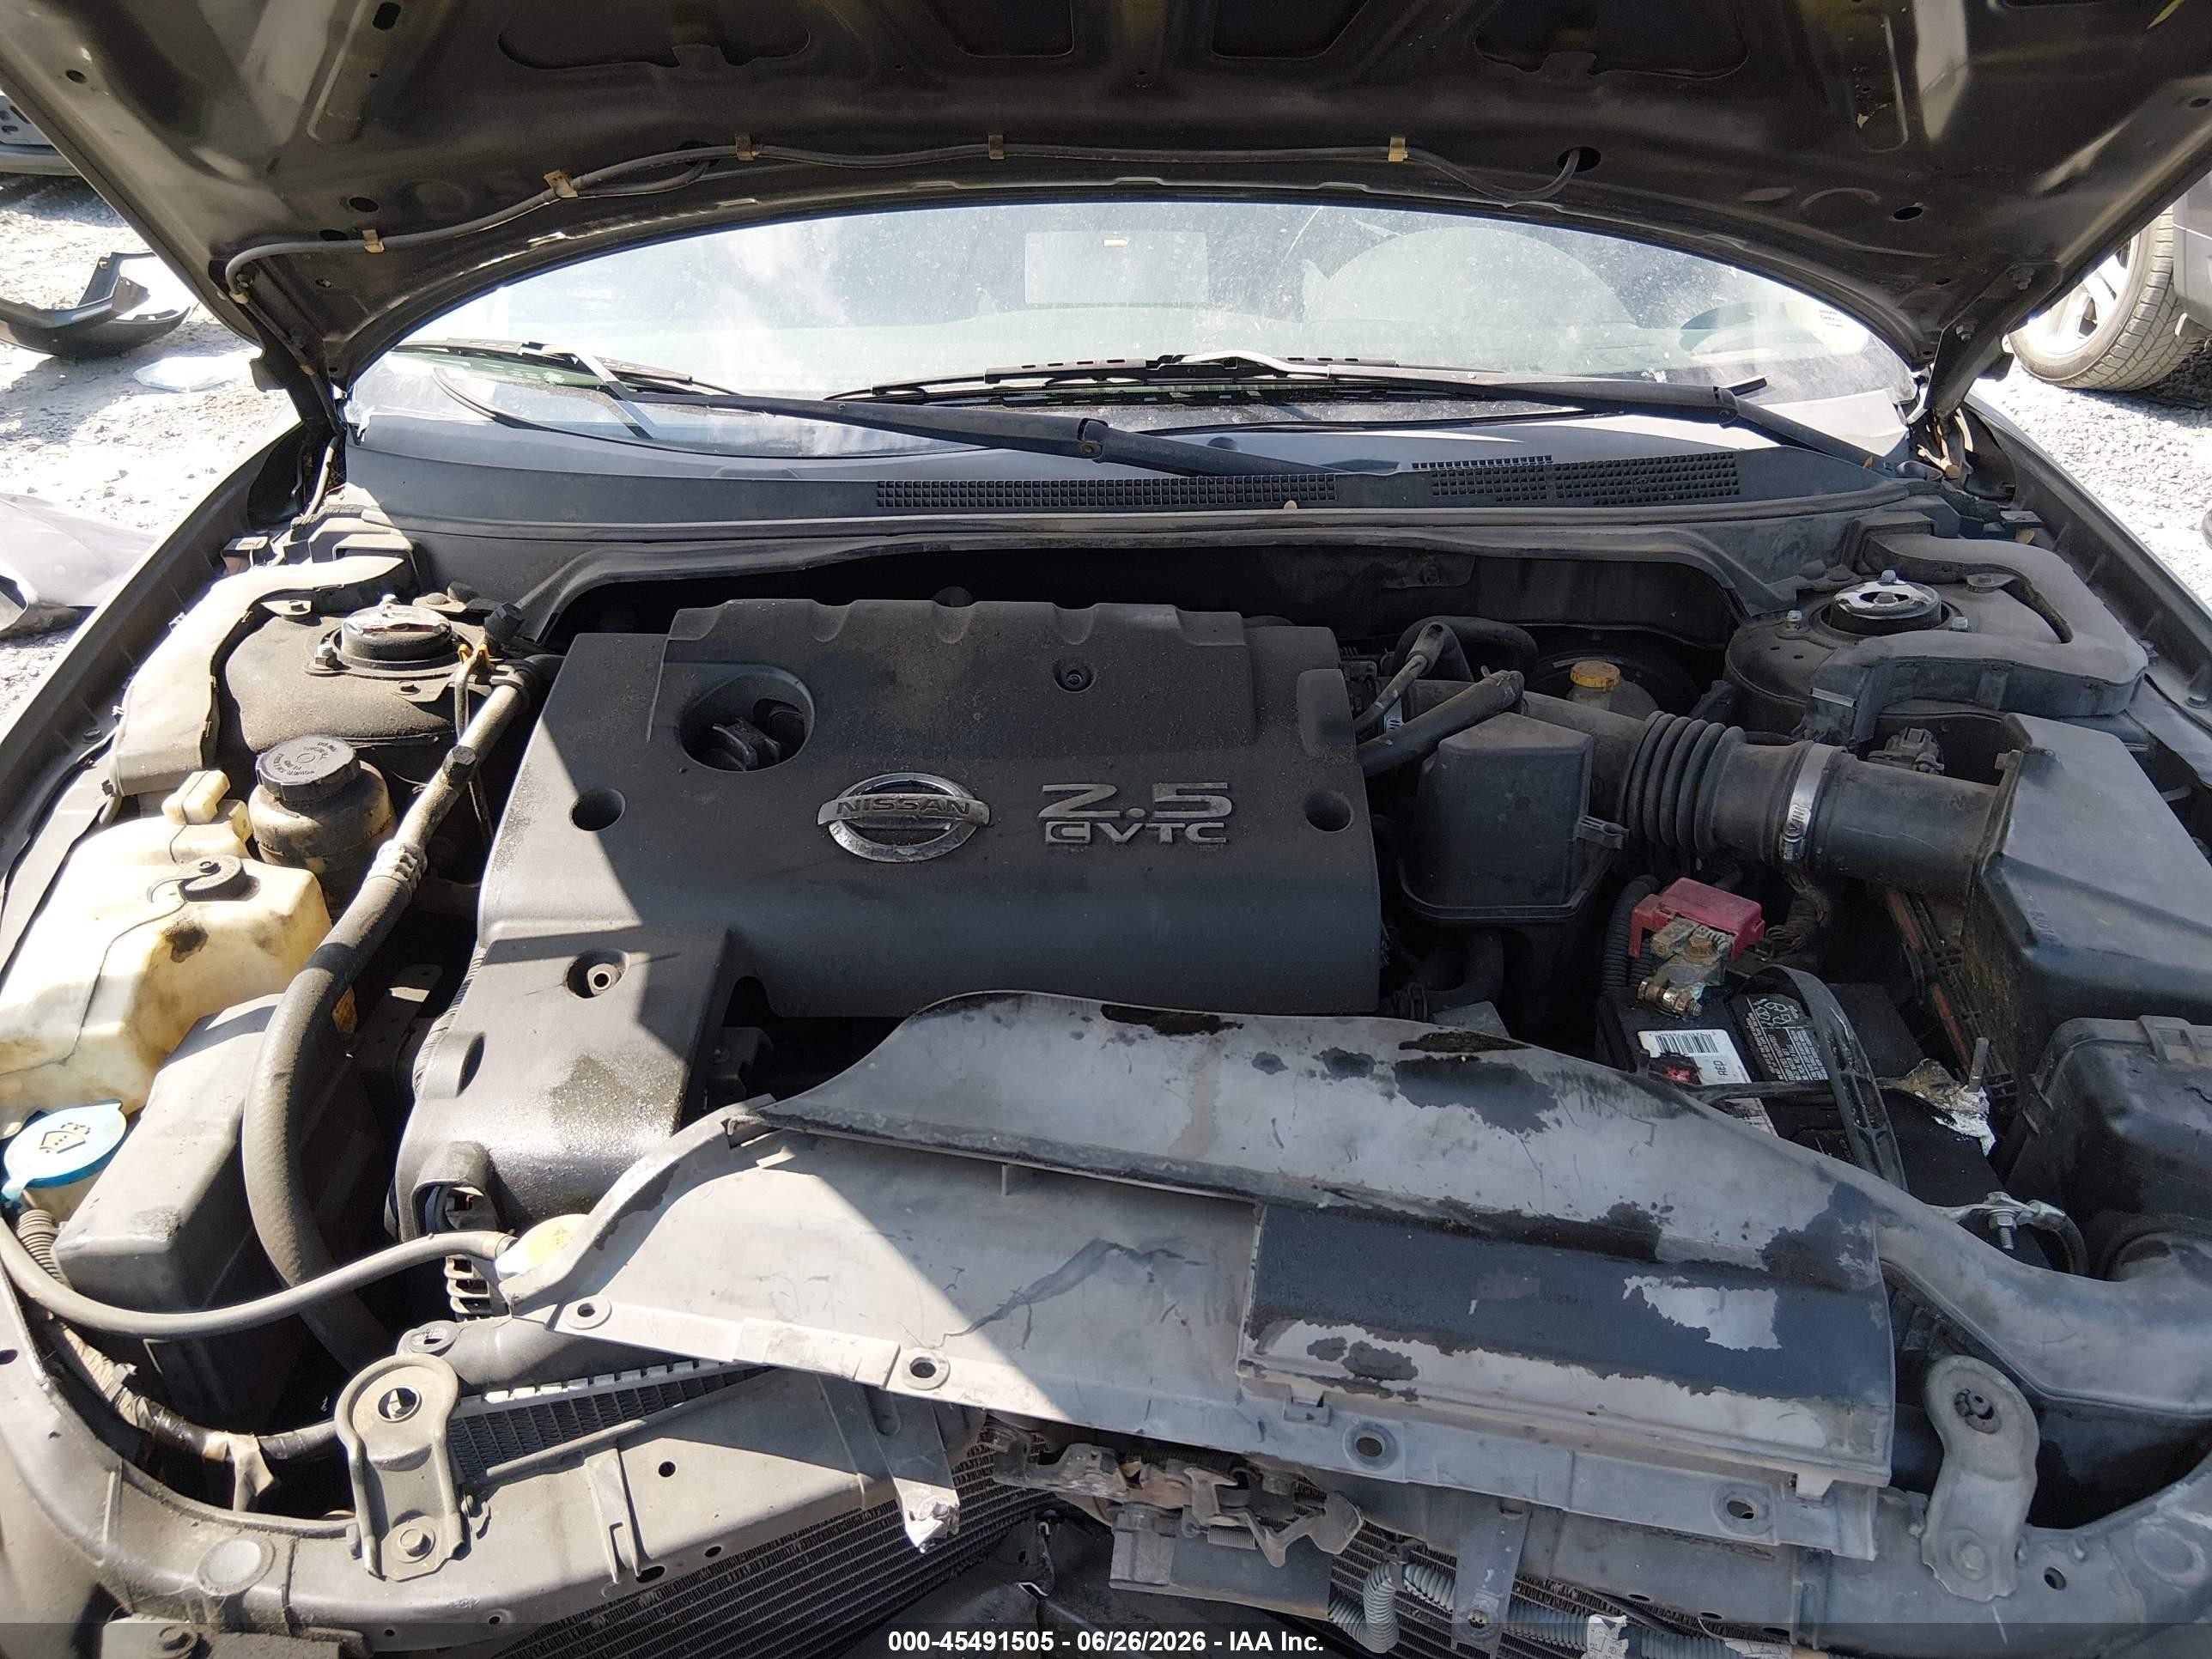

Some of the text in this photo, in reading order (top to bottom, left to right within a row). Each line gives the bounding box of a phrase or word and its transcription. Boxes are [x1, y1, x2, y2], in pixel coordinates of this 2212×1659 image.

[836, 797, 970, 815] NISSAN
[1037, 781, 1234, 819] 2.5
[1713, 1060, 1729, 1076] RED
